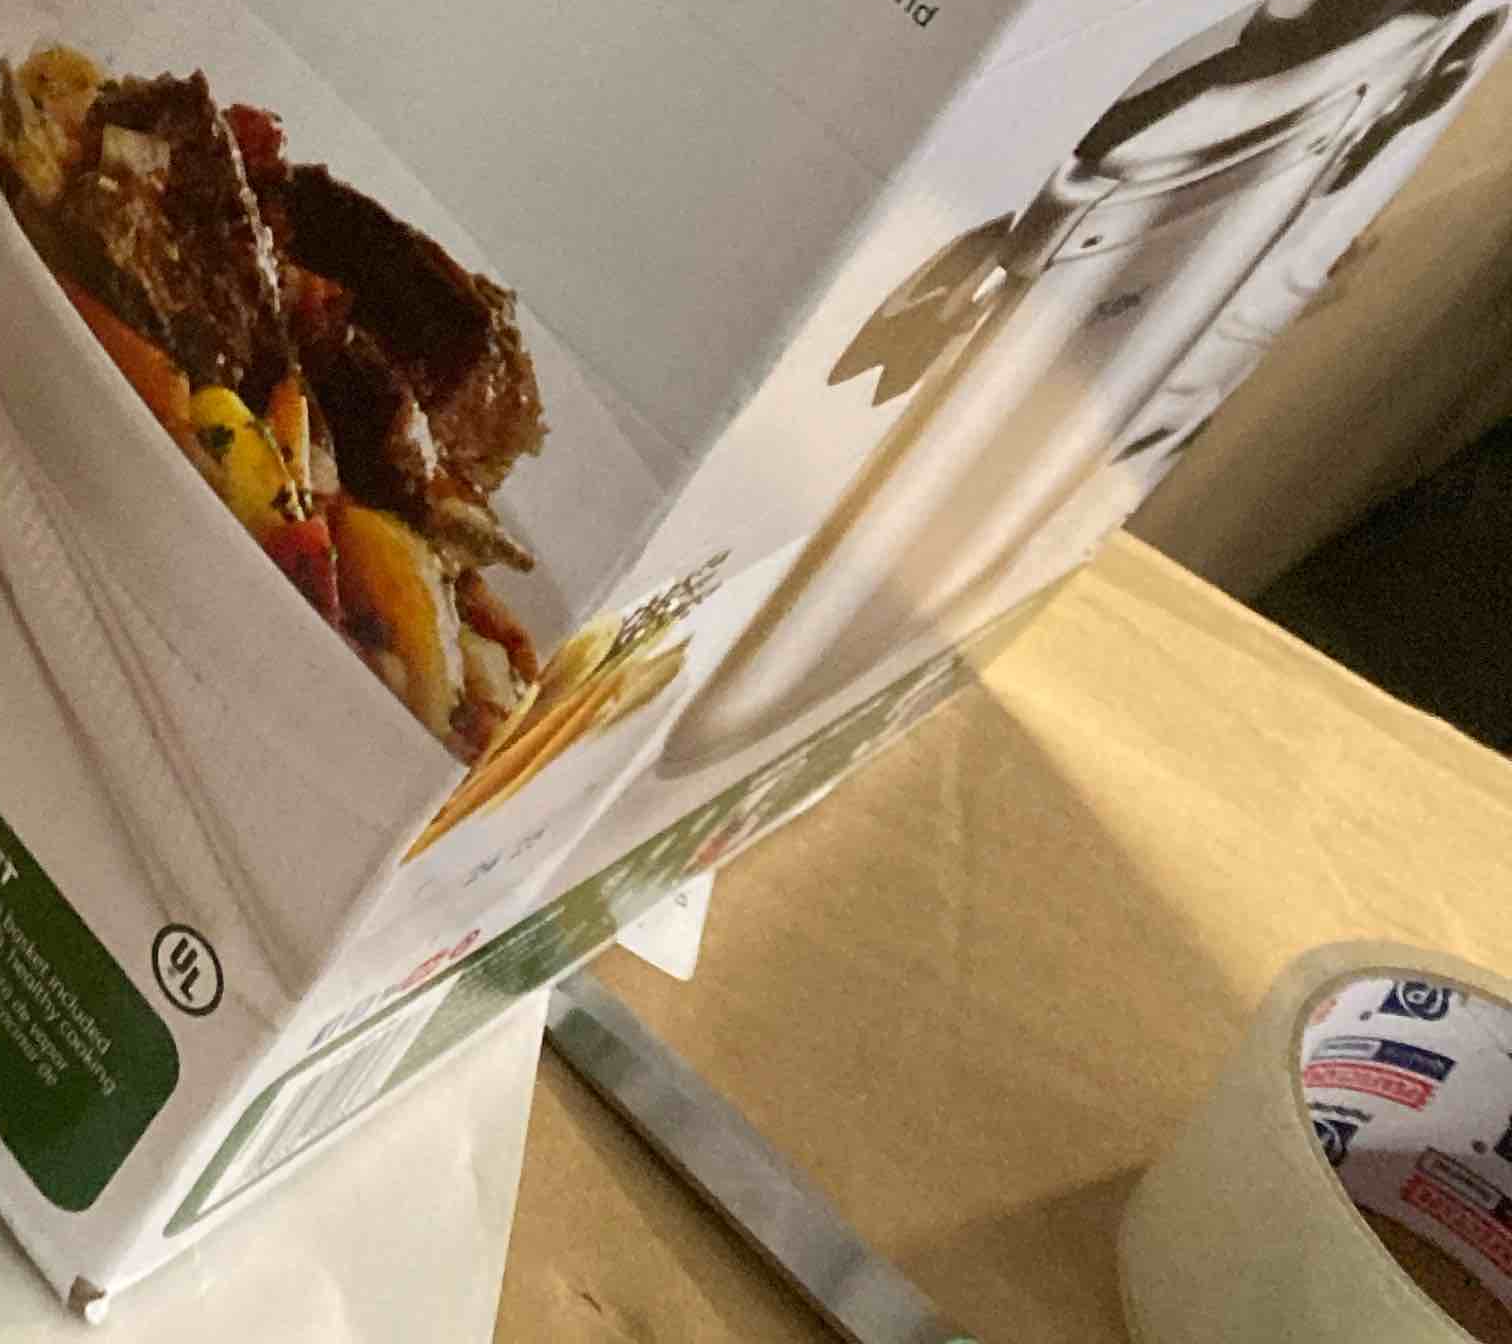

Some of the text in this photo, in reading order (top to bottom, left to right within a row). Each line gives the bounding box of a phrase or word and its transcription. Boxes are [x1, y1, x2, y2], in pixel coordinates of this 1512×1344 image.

[169, 936, 200, 1001] UL
[4, 947, 63, 1027] healthy
[55, 1016, 116, 1098] cooking
[47, 970, 111, 1056] included
